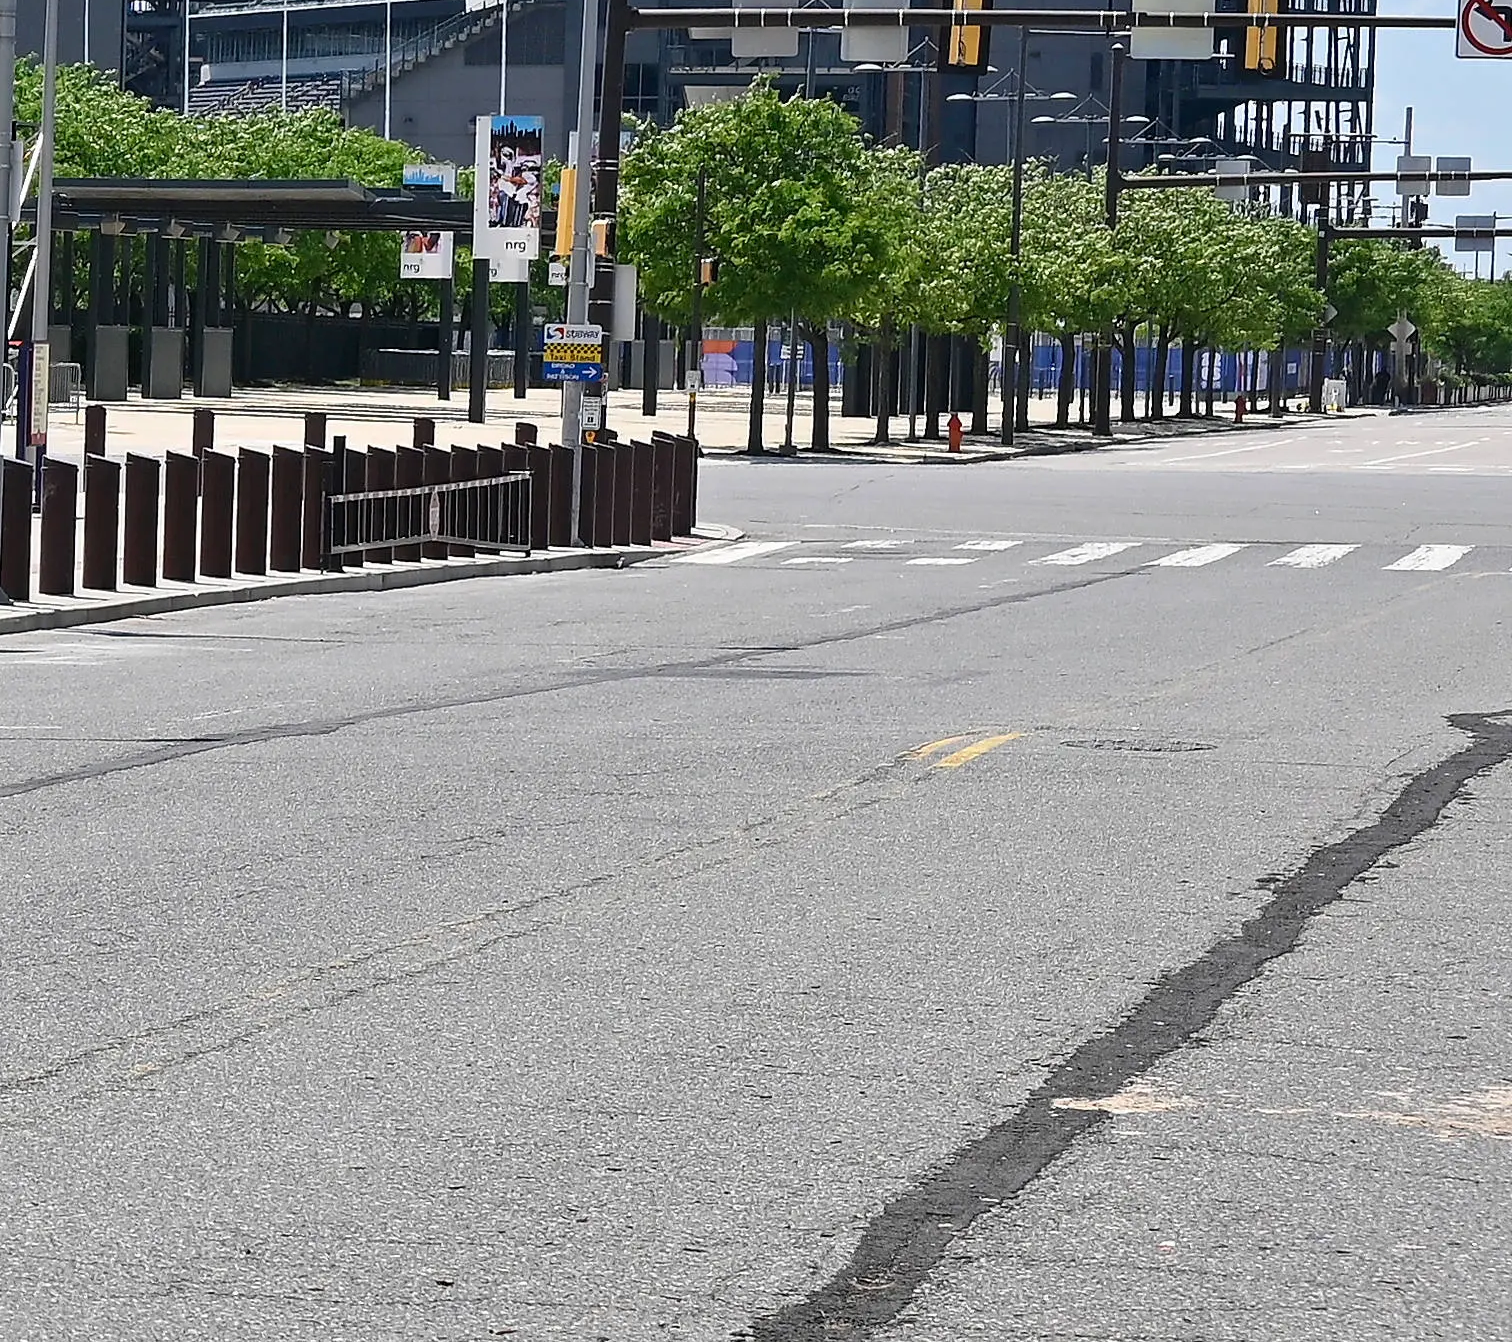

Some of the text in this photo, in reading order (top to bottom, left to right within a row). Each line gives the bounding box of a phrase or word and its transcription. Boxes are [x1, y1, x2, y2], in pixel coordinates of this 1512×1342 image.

[505, 240, 526, 253] nrg
[403, 263, 420, 273] nrg
[489, 268, 497, 277] rg
[565, 330, 600, 339] SUBWAY
